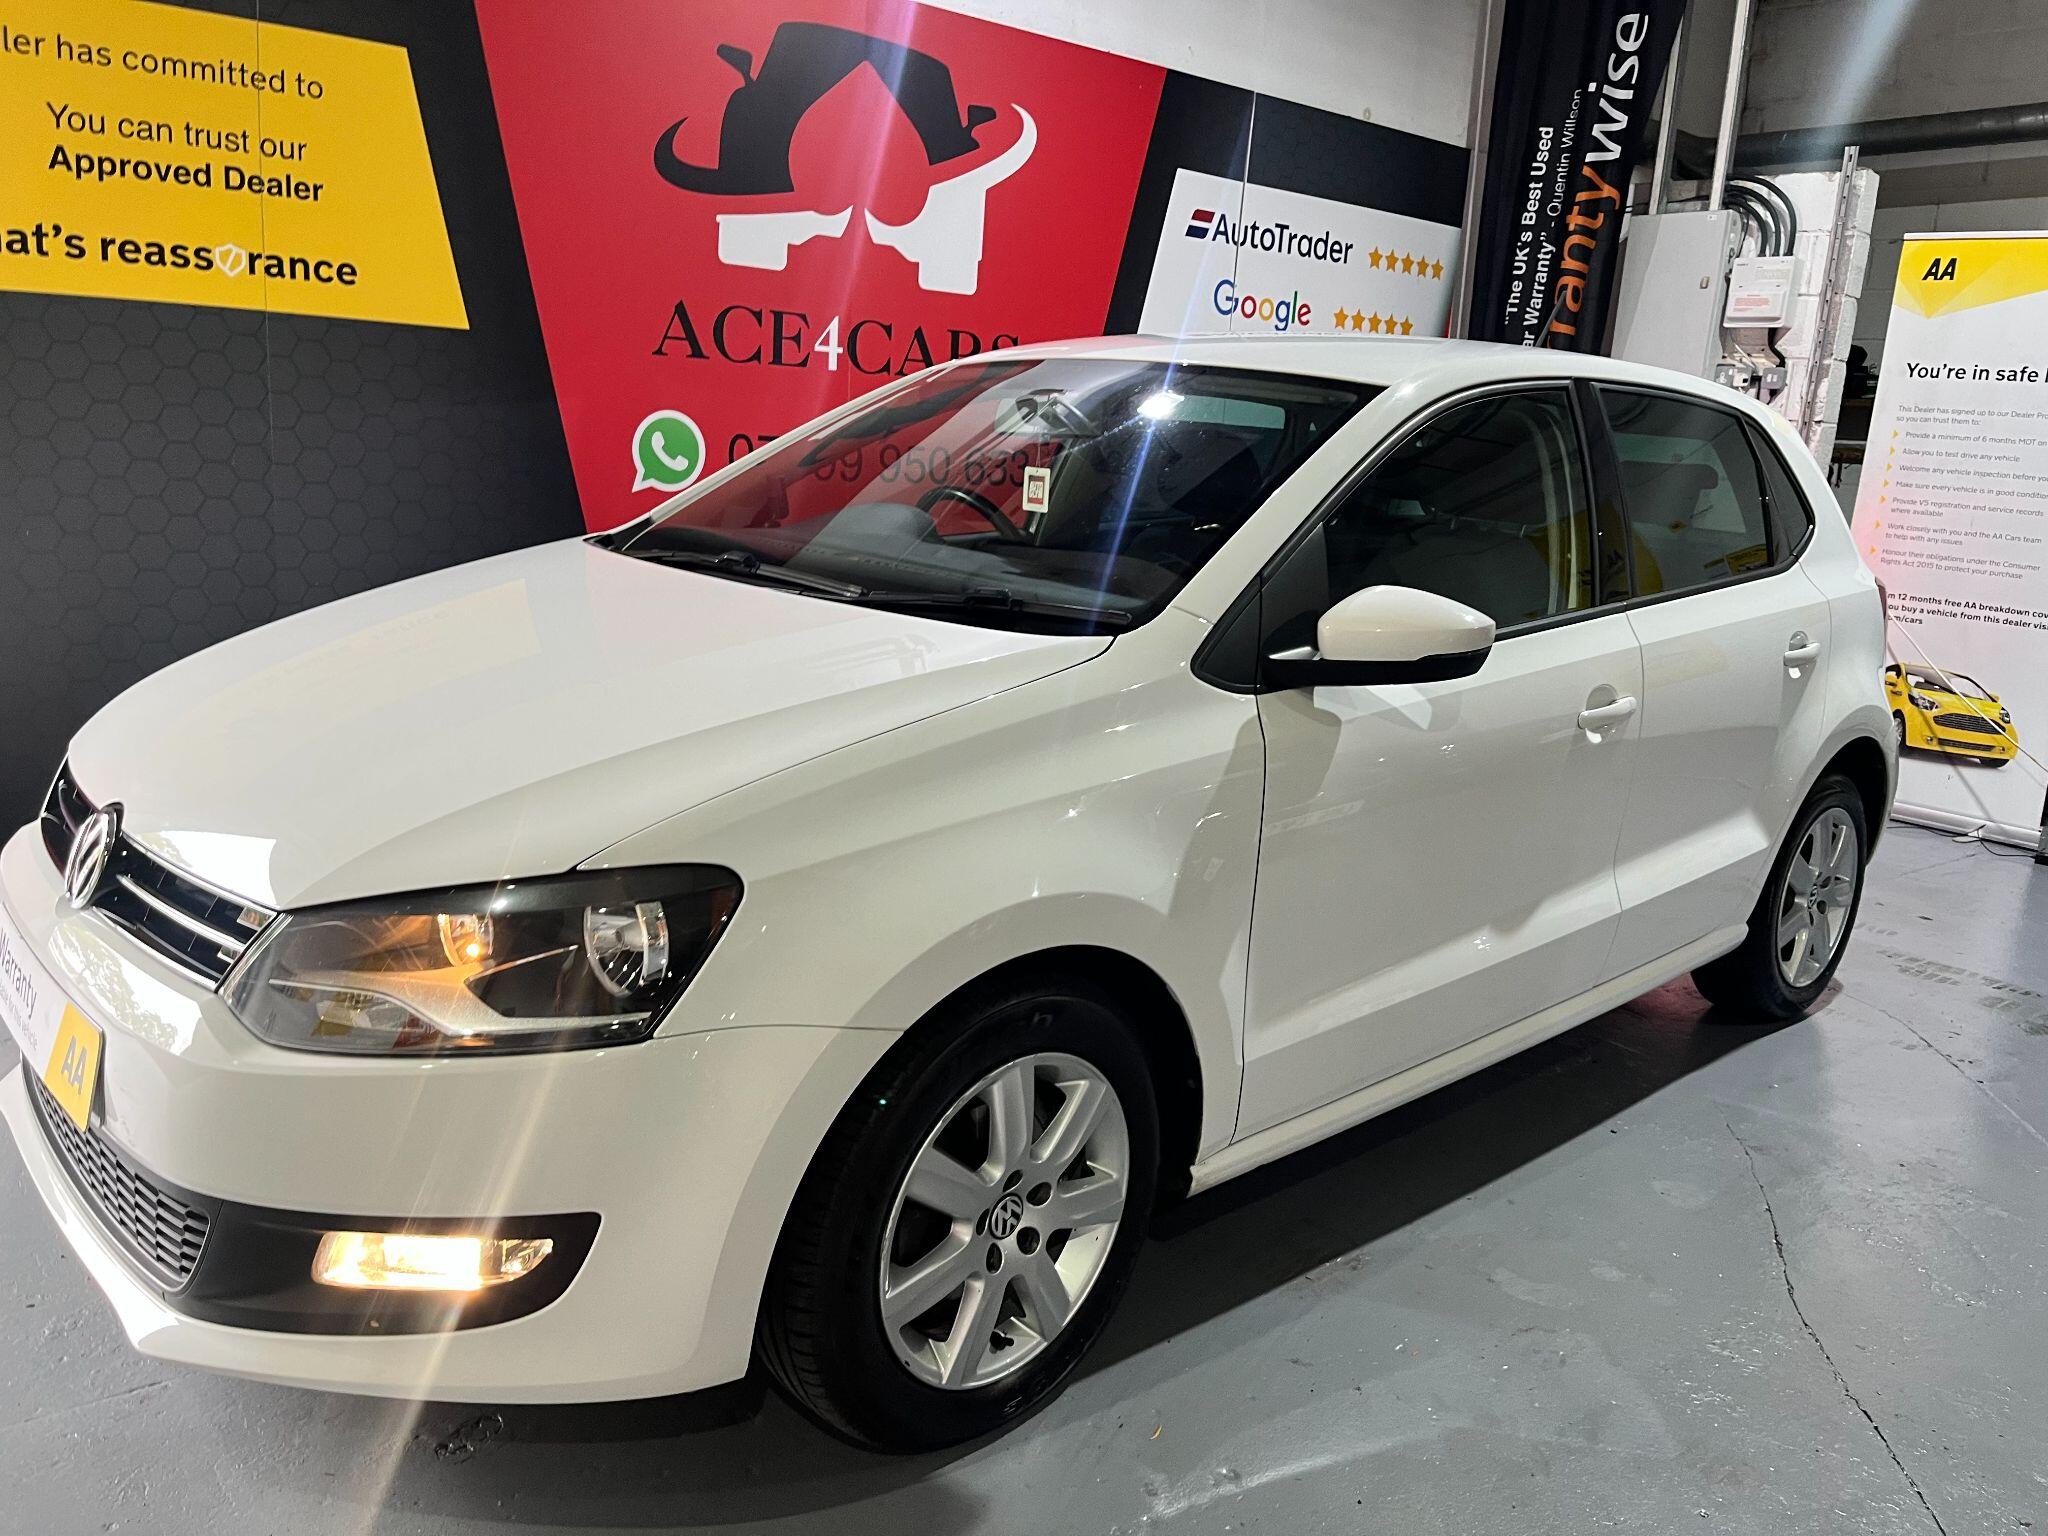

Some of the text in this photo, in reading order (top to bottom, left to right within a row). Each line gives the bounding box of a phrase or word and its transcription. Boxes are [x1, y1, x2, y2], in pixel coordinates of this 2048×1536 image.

[3, 25, 325, 99] ler has committed to
[46, 102, 308, 161] You can trust our
[1531, 126, 1554, 175] Used
[1547, 155, 1570, 216] Quentin
[1560, 89, 1582, 153] Willson
[48, 144, 324, 202] Approved Dealer
[1521, 179, 1543, 225] Best
[0, 222, 86, 260] at’s
[1212, 213, 1353, 264] AutoTrader
[1922, 258, 1957, 281] AA
[1213, 279, 1312, 331] Google
[1907, 362, 1966, 380] You’re
[1972, 364, 1990, 381] in
[1995, 366, 2039, 383] safe
[1914, 406, 1935, 414] Dealer
[1950, 409, 1976, 417] signed
[2011, 411, 2035, 419] Dealer
[1960, 452, 1978, 460] drive
[1994, 454, 2020, 462] vehicle
[1989, 437, 2016, 445] months
[2018, 438, 2036, 446] MOT
[879, 443, 950, 485] 950
[1900, 465, 1930, 473] Welcome
[1946, 468, 1972, 476] vehicle
[1973, 470, 2010, 479] inspection
[2012, 473, 2036, 481] before
[1932, 484, 1951, 492] every
[1953, 485, 1978, 494] vehicle
[1996, 490, 2015, 498] good
[1901, 605, 1918, 614] buy
[1926, 609, 1958, 618] vehicle
[1960, 612, 1981, 621] from
[1983, 615, 2000, 624] this
[2002, 617, 2032, 628] dealer
[1909, 594, 1942, 605] months
[1944, 598, 1962, 608] free
[1964, 601, 1977, 610] AA
[1978, 602, 2030, 617] breakdown
[60, 1034, 88, 1096] AA
